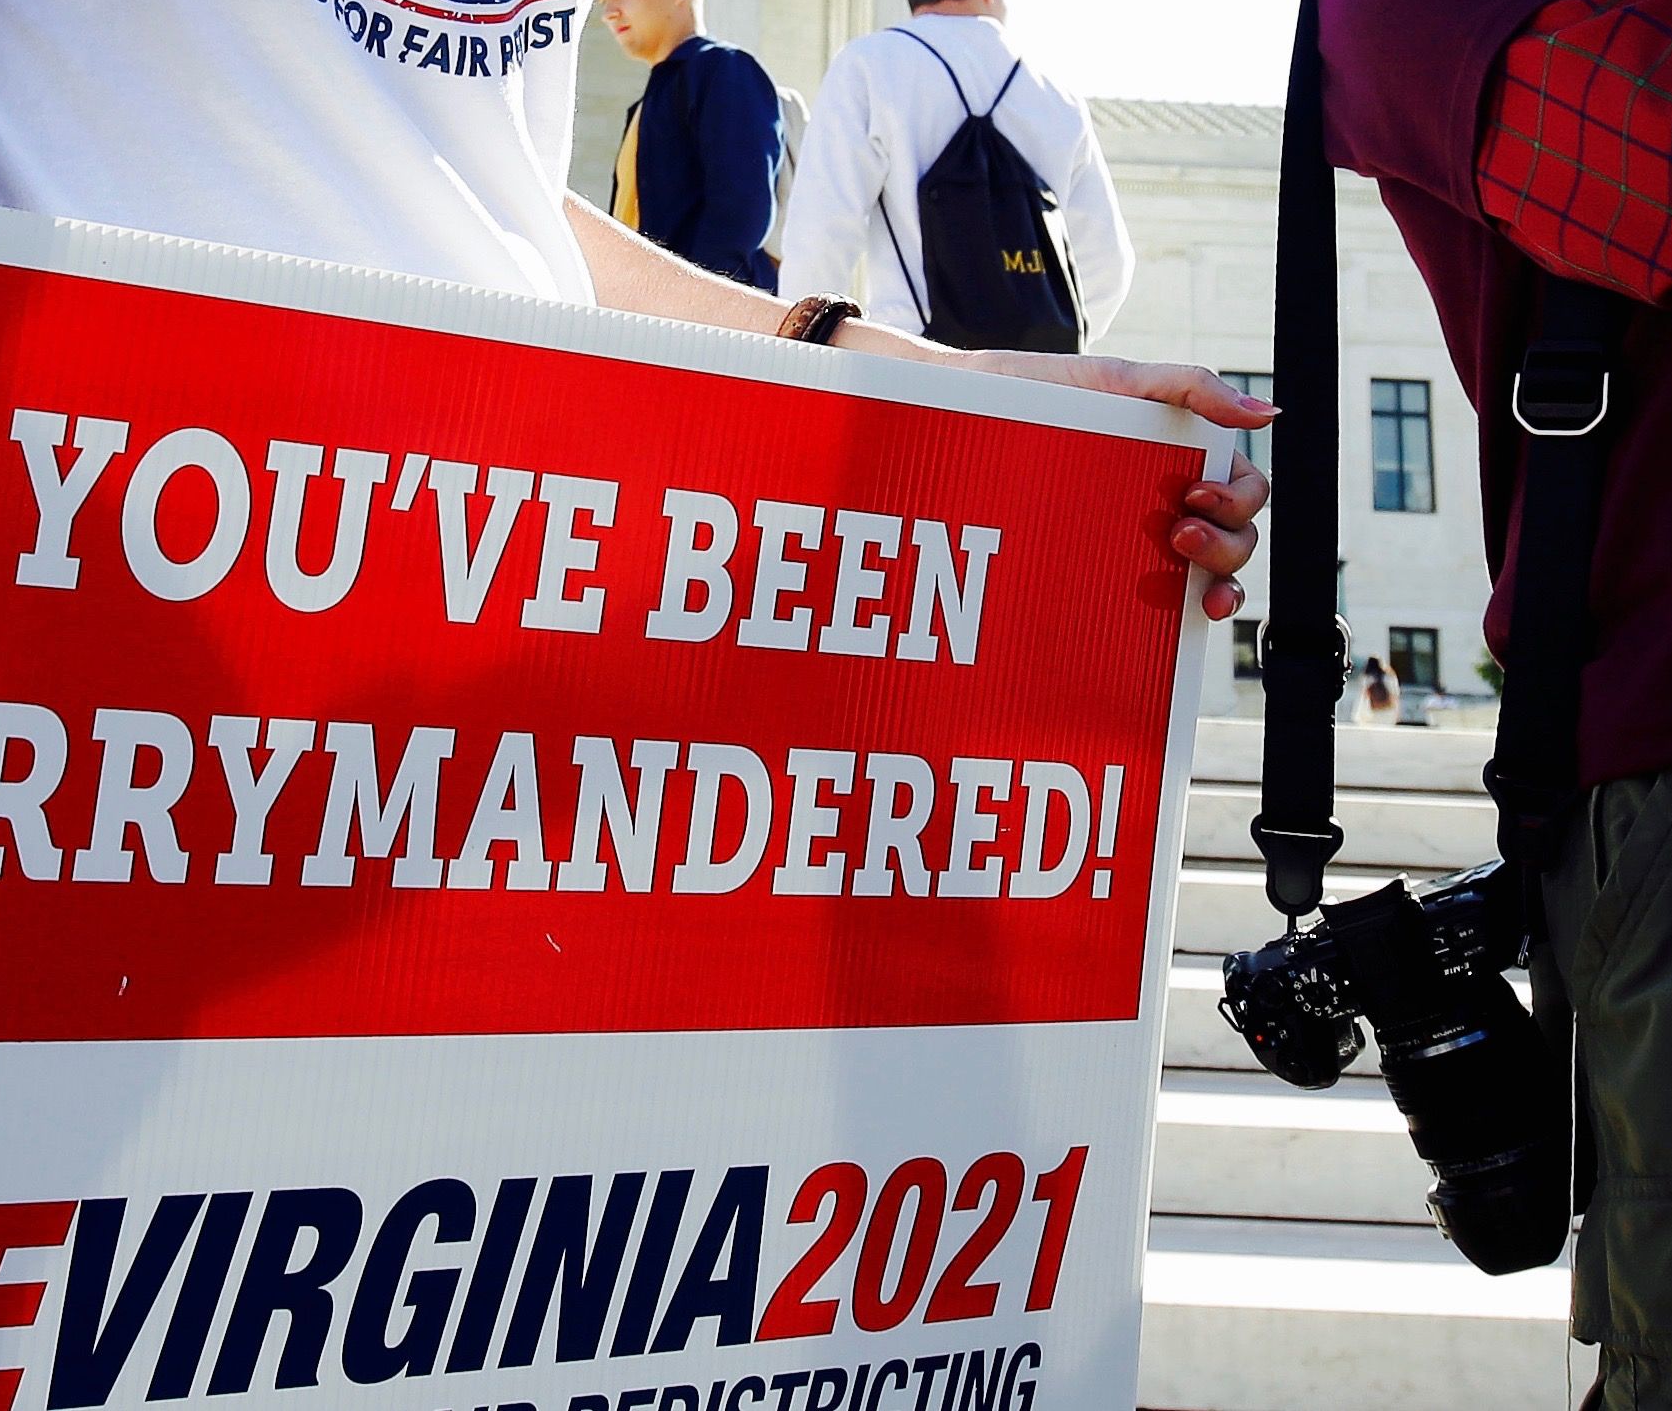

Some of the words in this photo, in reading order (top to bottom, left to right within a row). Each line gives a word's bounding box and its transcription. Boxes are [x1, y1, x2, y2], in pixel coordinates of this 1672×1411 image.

[398, 24, 492, 78] FAIR
[10, 408, 620, 634] YOU'VE
[645, 488, 1003, 666] BEEN
